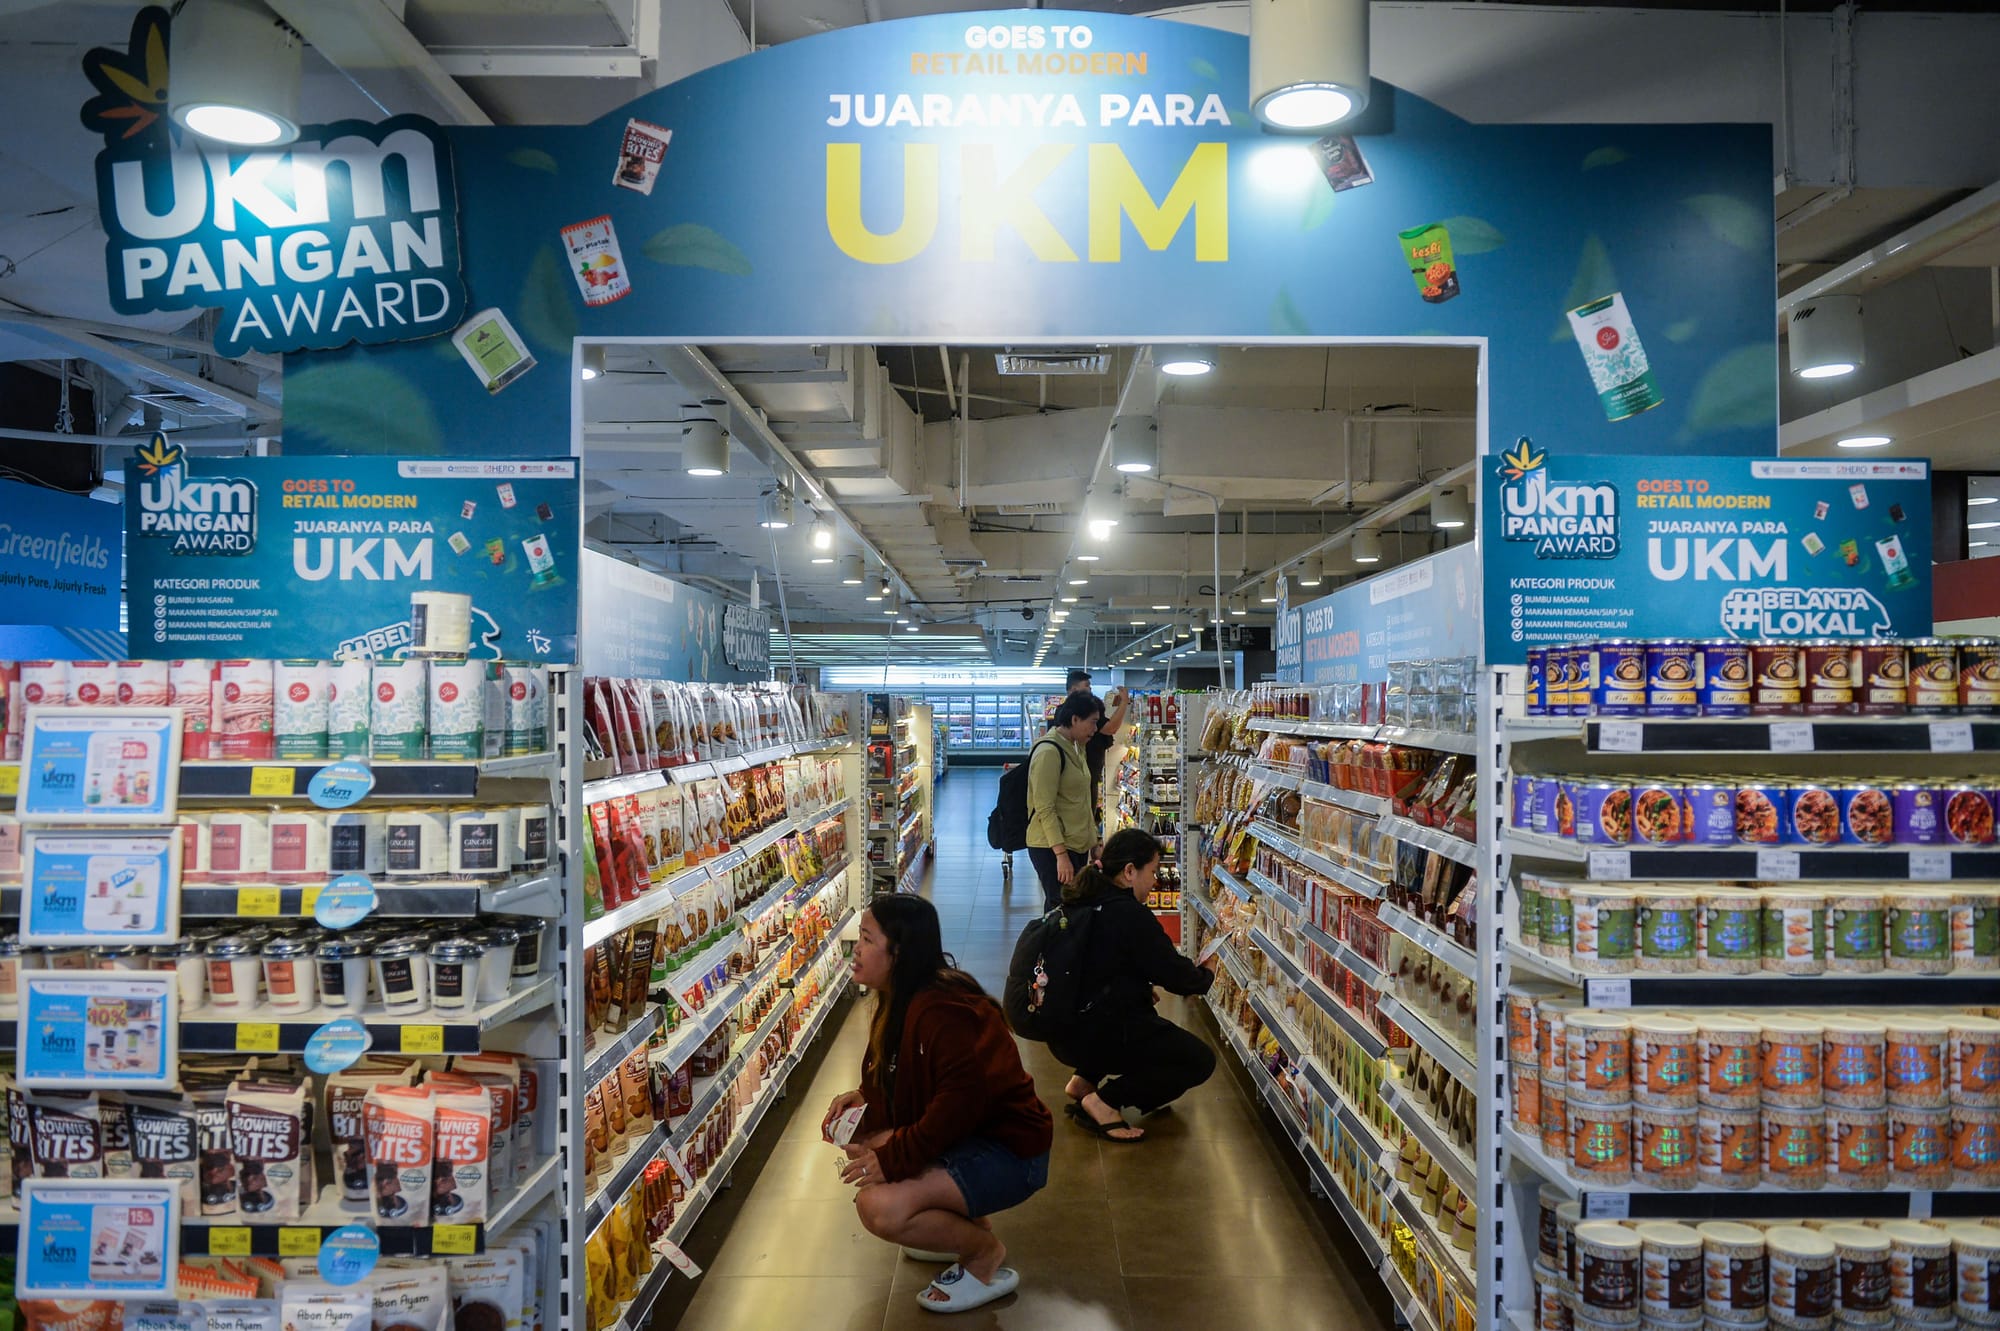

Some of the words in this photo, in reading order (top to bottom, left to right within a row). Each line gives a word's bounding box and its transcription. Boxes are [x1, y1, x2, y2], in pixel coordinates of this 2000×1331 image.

[965, 25, 1045, 49] GOES
[1050, 25, 1093, 49] TO
[910, 51, 1009, 75] RETAIL
[1017, 51, 1148, 75] MODERN
[826, 93, 1087, 127] JUARANYA
[1100, 93, 1231, 126] PARA
[626, 141, 660, 161] BITES
[826, 142, 1228, 265] UKM
[122, 217, 442, 300] PANGAN
[229, 277, 450, 344] AWARD
[140, 464, 250, 513] ukm
[282, 479, 328, 493] GOES
[333, 479, 355, 493] TO
[1506, 467, 1615, 516] ukm
[1637, 479, 1683, 493] GOES
[1686, 479, 1710, 493] TO
[282, 494, 339, 508] RETAIL
[343, 494, 417, 508] MODERN
[1637, 495, 1693, 509] RETAIL
[1697, 495, 1771, 509] MODERN
[141, 512, 250, 533] PANGAN
[294, 520, 384, 534] JUARANYA
[388, 520, 434, 534] PARA
[1508, 516, 1615, 536] PANGAN
[1648, 520, 1738, 534] JUARANYA
[1742, 520, 1788, 534] PARA
[174, 534, 250, 550] AWARD
[1541, 537, 1616, 553] AWARD
[293, 537, 433, 581] UKM
[1647, 537, 1788, 582] UKM
[0, 571, 26, 587] ujurly
[84, 582, 106, 595] Fresh
[154, 579, 209, 590] KATEGORI
[212, 579, 260, 590] PRODUK
[1510, 578, 1566, 589] KATEGORI
[1567, 578, 1615, 589] PRODUK
[1525, 595, 1551, 604] BUMBU
[1553, 595, 1589, 604] MASAKAN
[1306, 608, 1324, 635] GOES
[1324, 605, 1334, 630] TO
[1525, 608, 1563, 617] MAKANAN
[1525, 620, 1563, 629] MAKANAN
[1764, 612, 1865, 635] LOKAL
[1525, 633, 1563, 642] MINUMAN
[463, 837, 493, 847] GINGER
[90, 1007, 128, 1027] 10%
[36, 1118, 94, 1135] BROWNIES
[232, 1117, 292, 1134] BROWNIES
[368, 1118, 424, 1138] BROWNIES
[434, 1119, 480, 1135] OWNIES
[38, 1134, 96, 1160] BITES
[234, 1133, 291, 1161] BITES
[437, 1135, 479, 1161] TES
[400, 1294, 429, 1309] Ayam
[208, 1318, 233, 1331] Abon
[297, 1309, 322, 1321] Abon
[325, 1309, 353, 1325] Ayam
